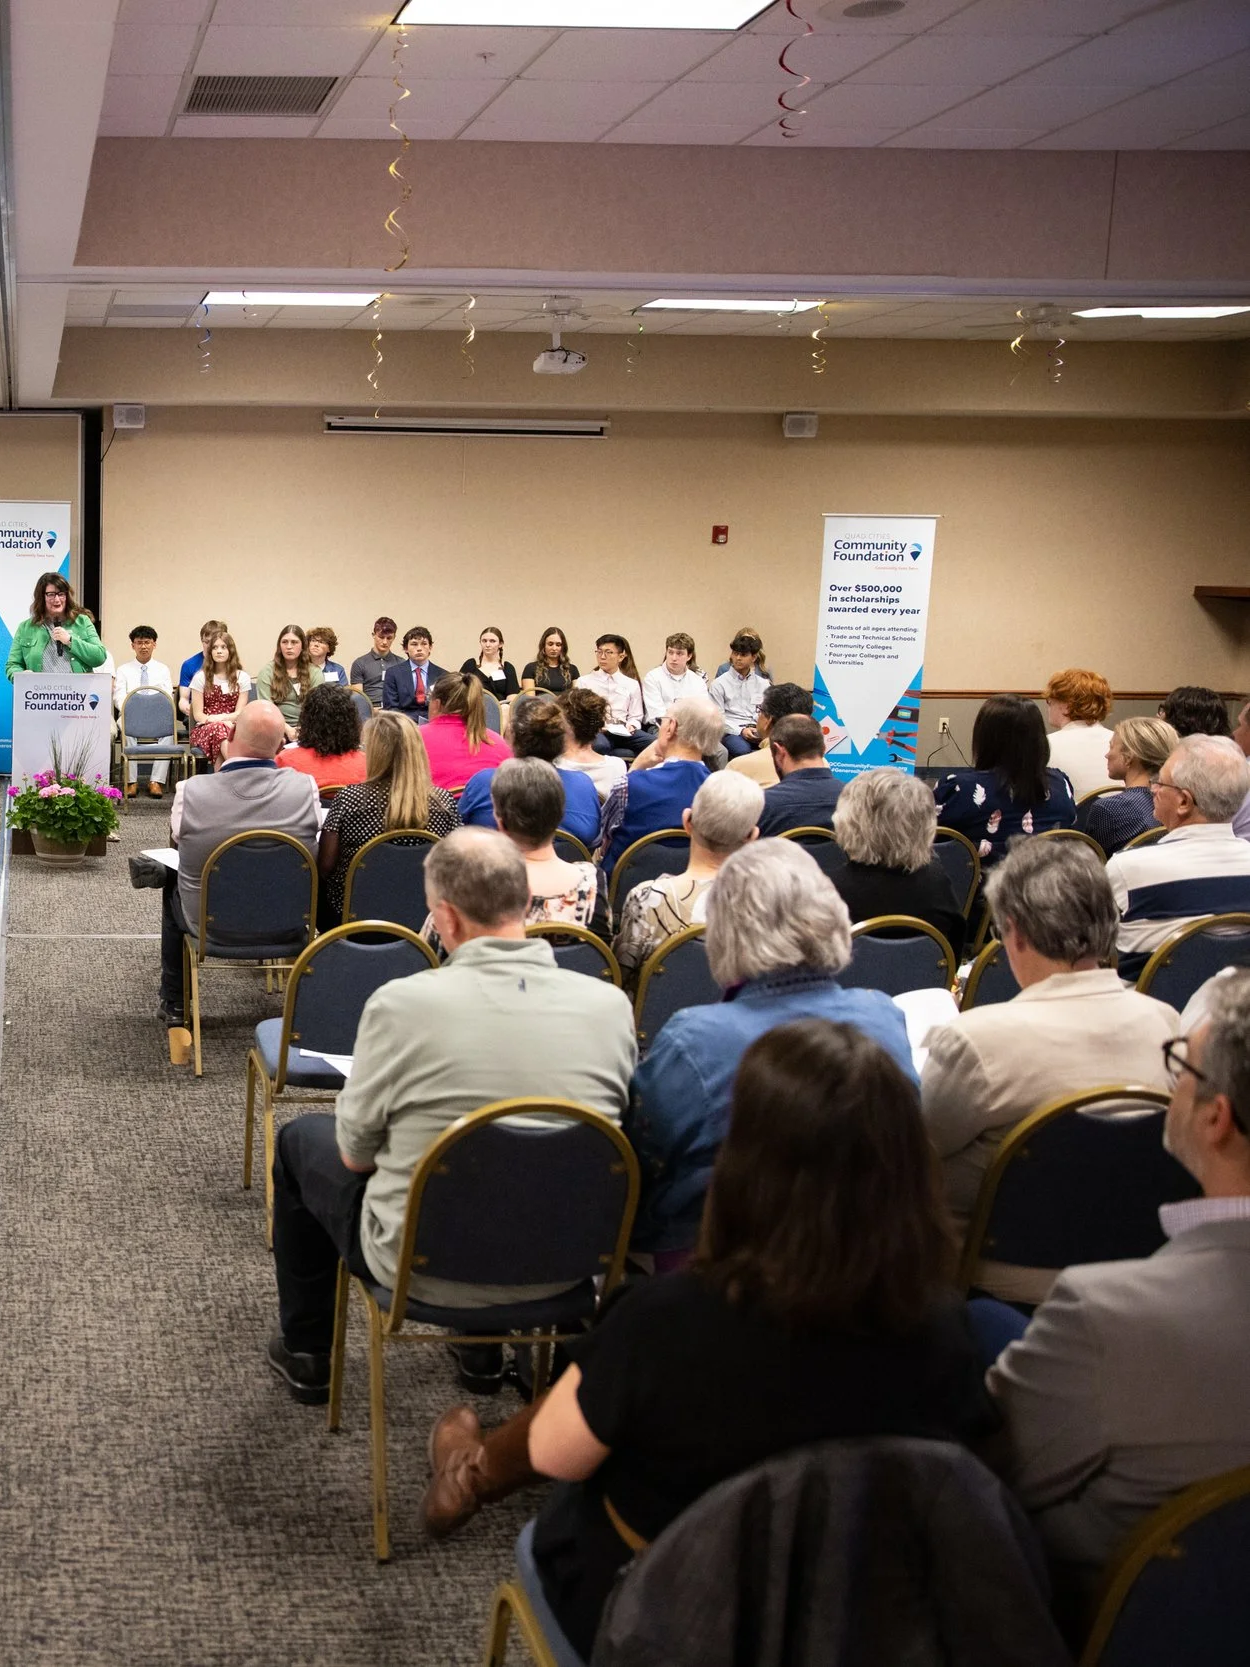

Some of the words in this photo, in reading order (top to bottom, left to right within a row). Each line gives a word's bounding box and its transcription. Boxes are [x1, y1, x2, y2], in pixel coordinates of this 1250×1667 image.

[834, 539, 907, 554] Community
[833, 550, 904, 562] Foundation
[829, 584, 852, 592] Over
[854, 584, 903, 593] $500,000
[828, 594, 838, 602] in
[840, 595, 900, 605] scholarships
[827, 606, 869, 614] awarded
[871, 608, 897, 616] every
[899, 608, 921, 616] year
[829, 642, 865, 650] Community
[24, 691, 87, 703] Community
[24, 701, 85, 711] Foundation
